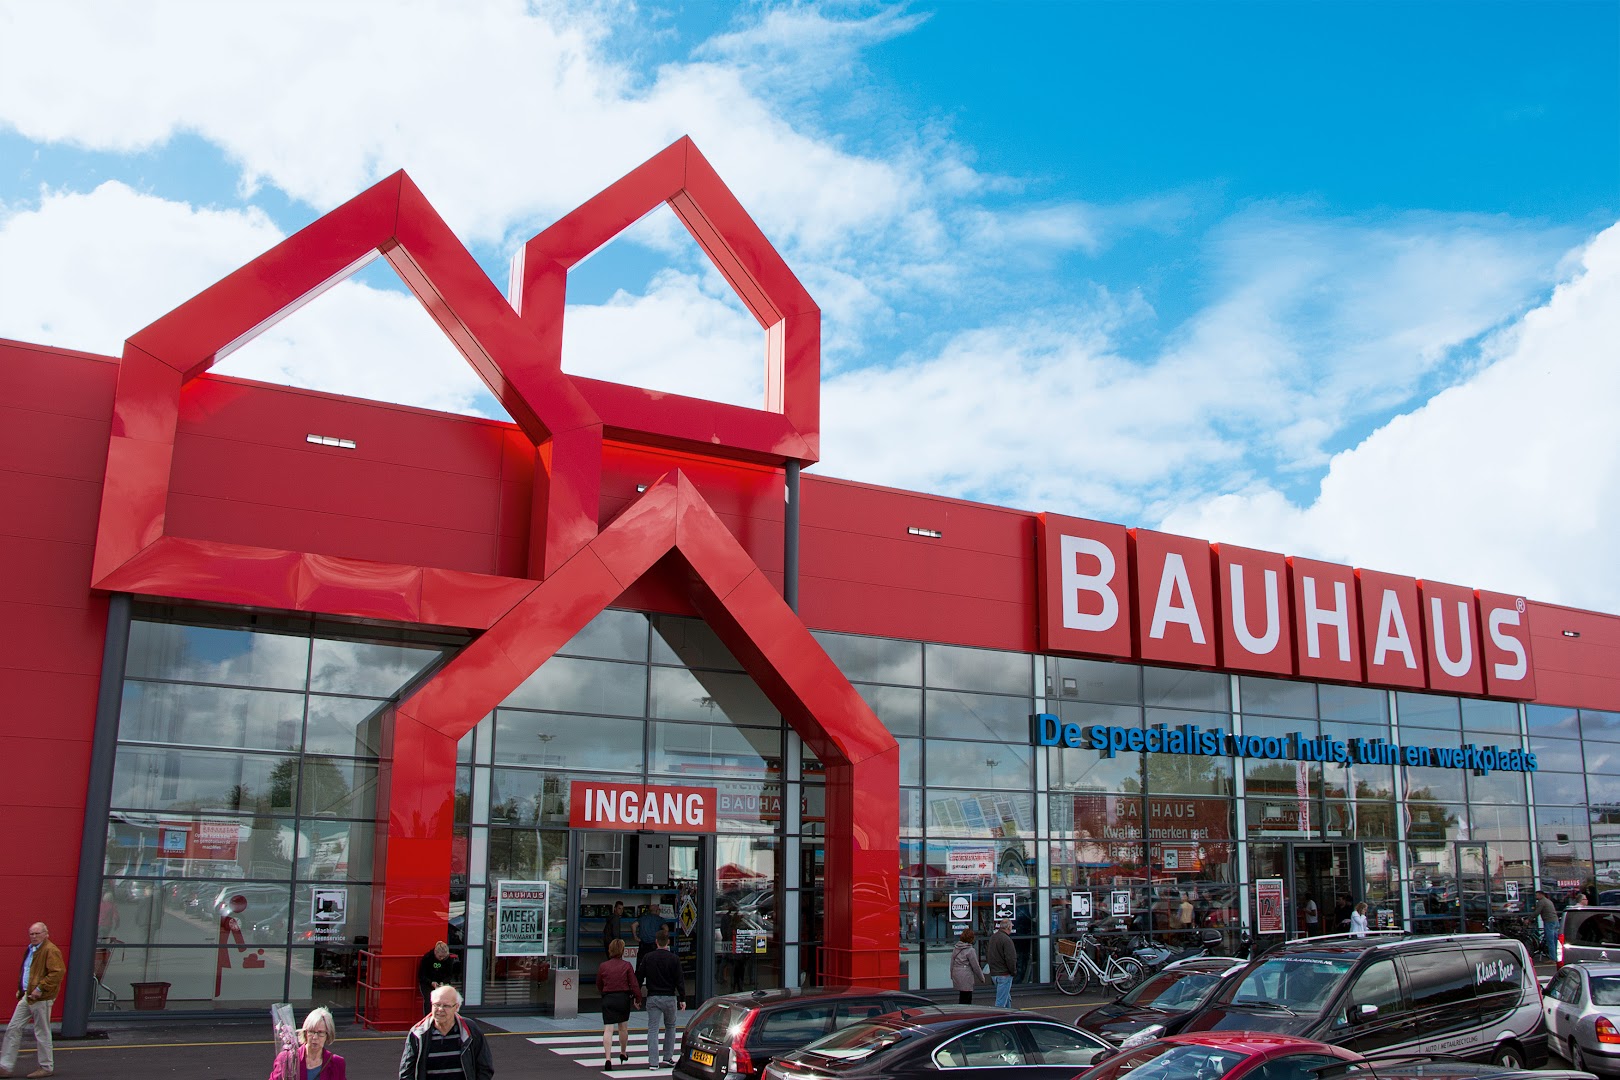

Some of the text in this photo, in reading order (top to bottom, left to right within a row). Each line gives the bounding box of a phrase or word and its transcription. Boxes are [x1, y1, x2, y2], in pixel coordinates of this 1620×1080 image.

[1038, 713, 1538, 776] De specialist voor huis, tuin en werkplaats
[584, 788, 704, 825] INGANG
[1116, 802, 1196, 818] BAHAUS
[952, 903, 970, 911] QUALITY
[501, 910, 536, 922] MEER
[501, 923, 536, 933] DAN EEN
[1475, 959, 1514, 986] Klaas Boer
[1425, 1035, 1478, 1053] AUTO METAALRECYCLING
